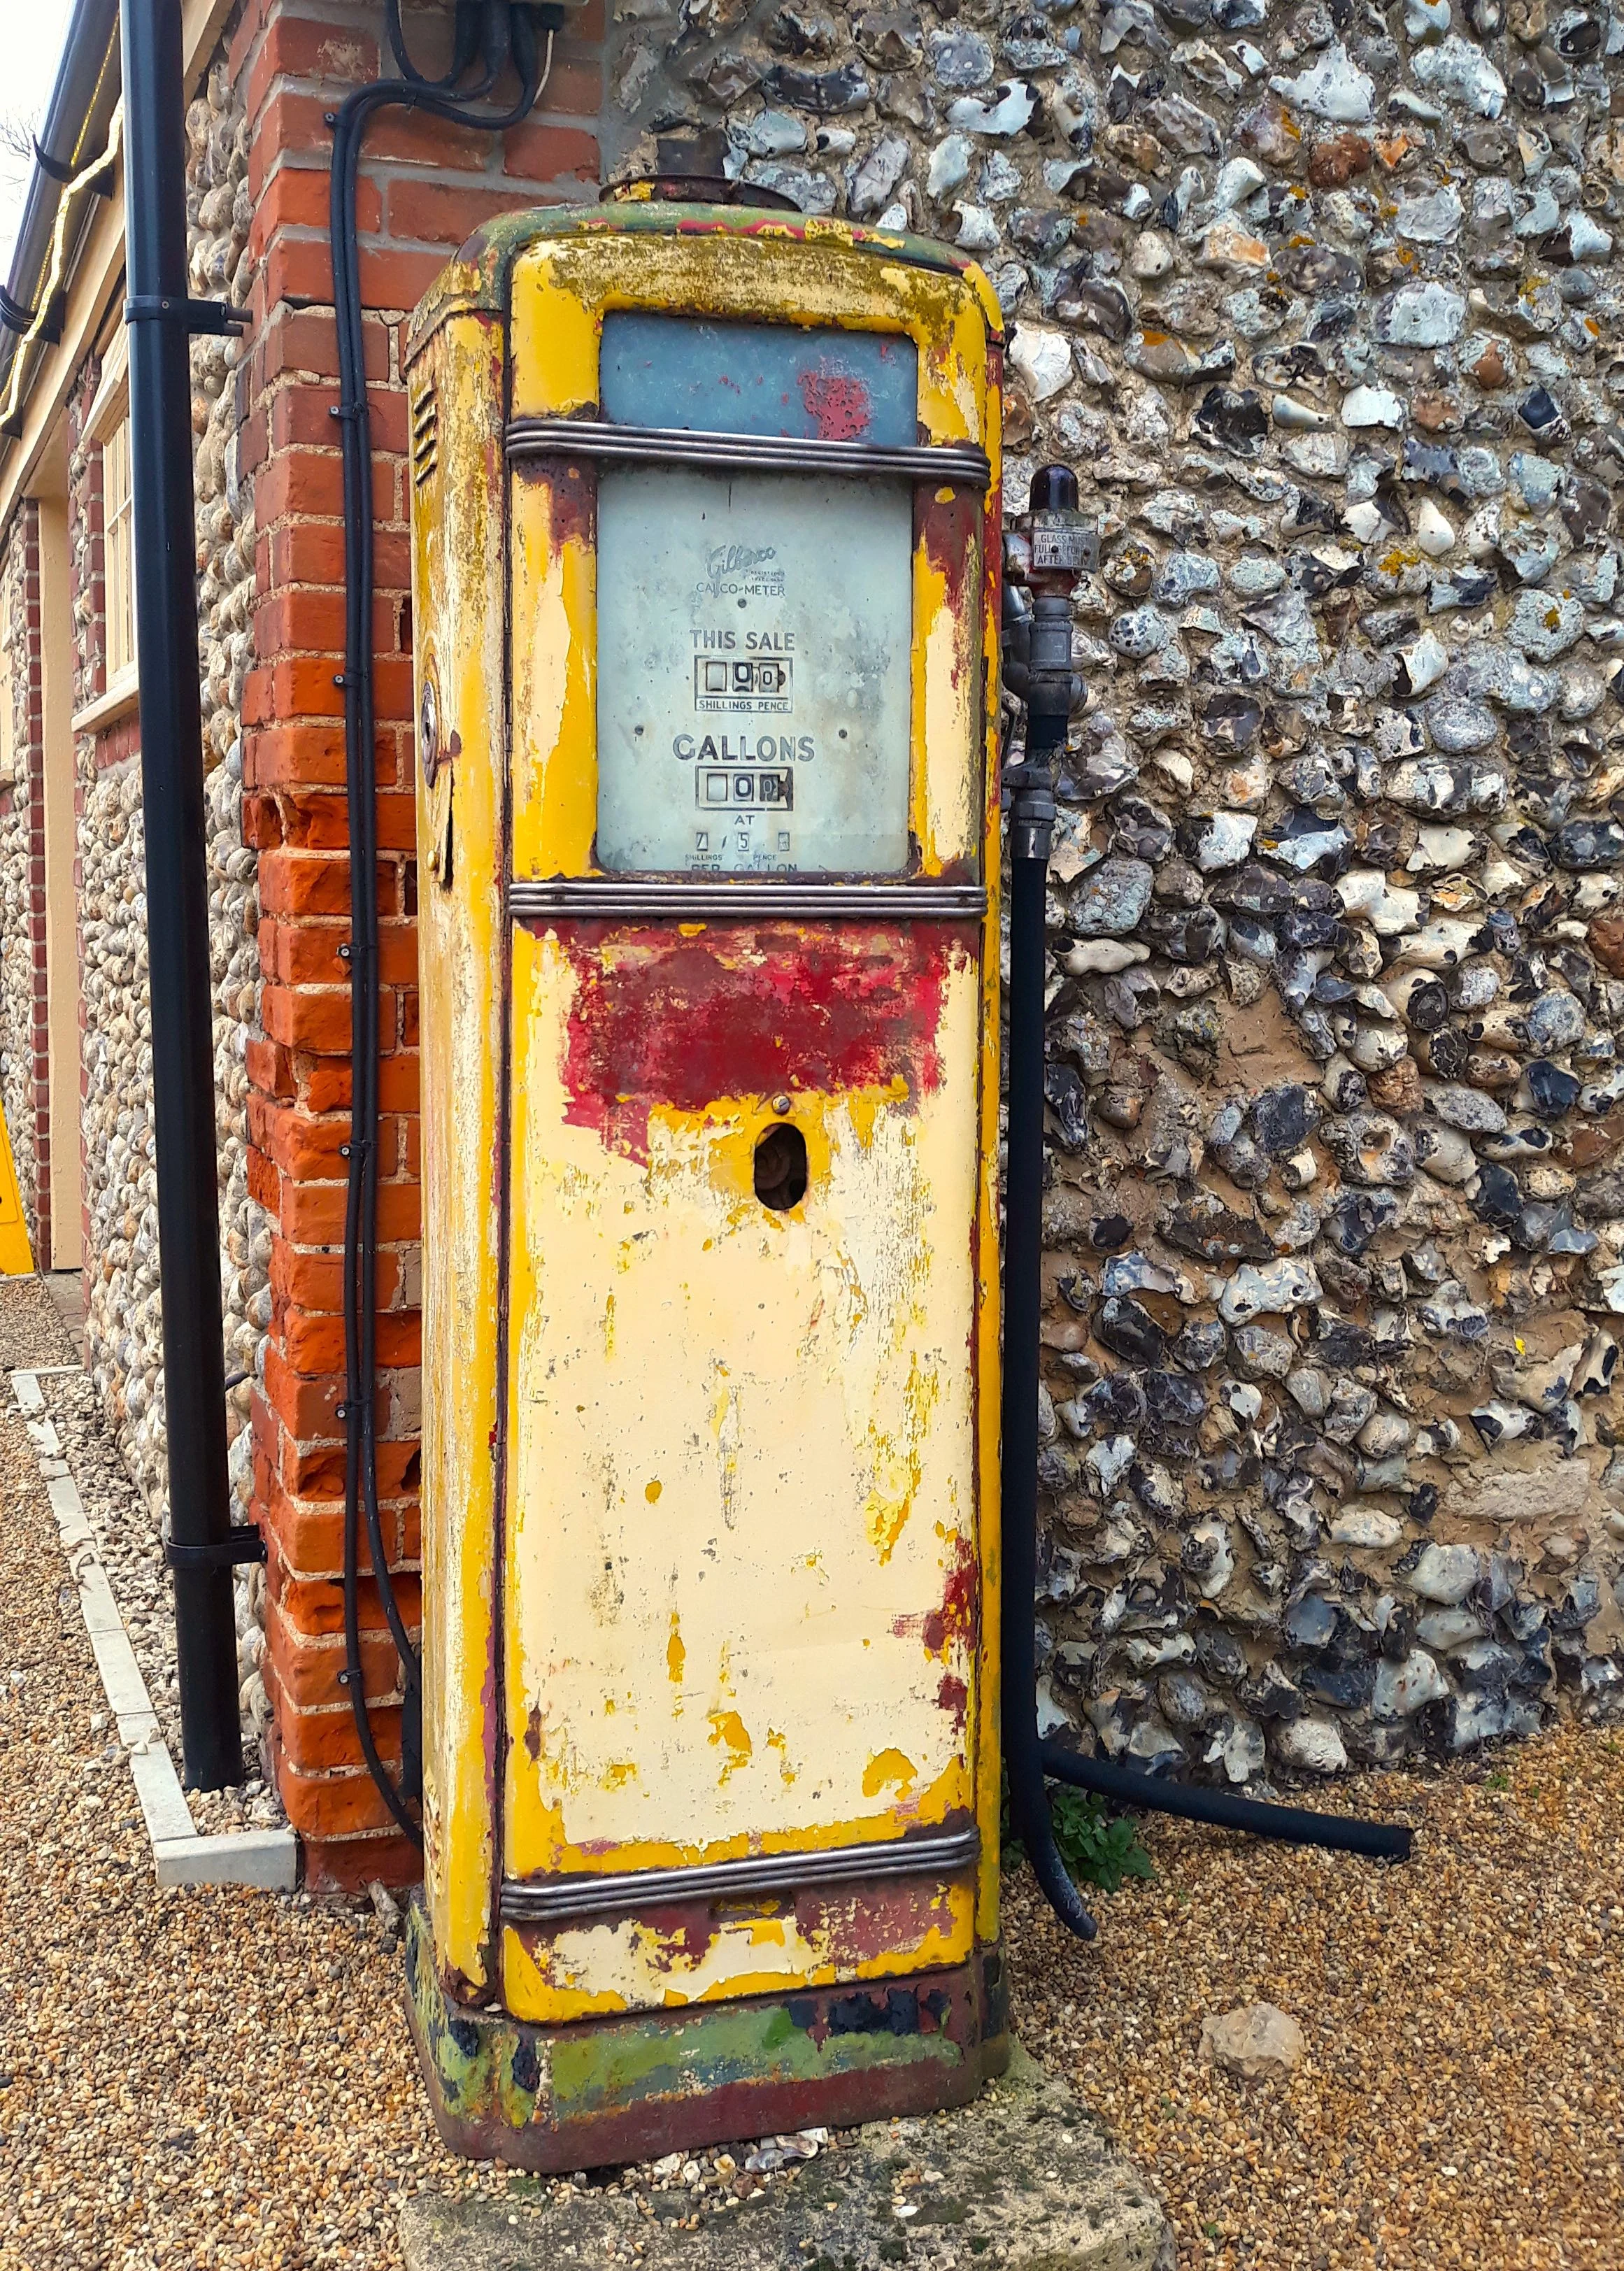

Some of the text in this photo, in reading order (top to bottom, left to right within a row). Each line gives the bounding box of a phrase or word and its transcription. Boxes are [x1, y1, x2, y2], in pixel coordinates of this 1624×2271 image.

[1041, 534, 1066, 545] GLASS
[690, 629, 795, 650] THIS SALE
[699, 700, 789, 711] SHILLINGS PENCE
[673, 734, 815, 762] GALLONS
[734, 815, 755, 825] AT
